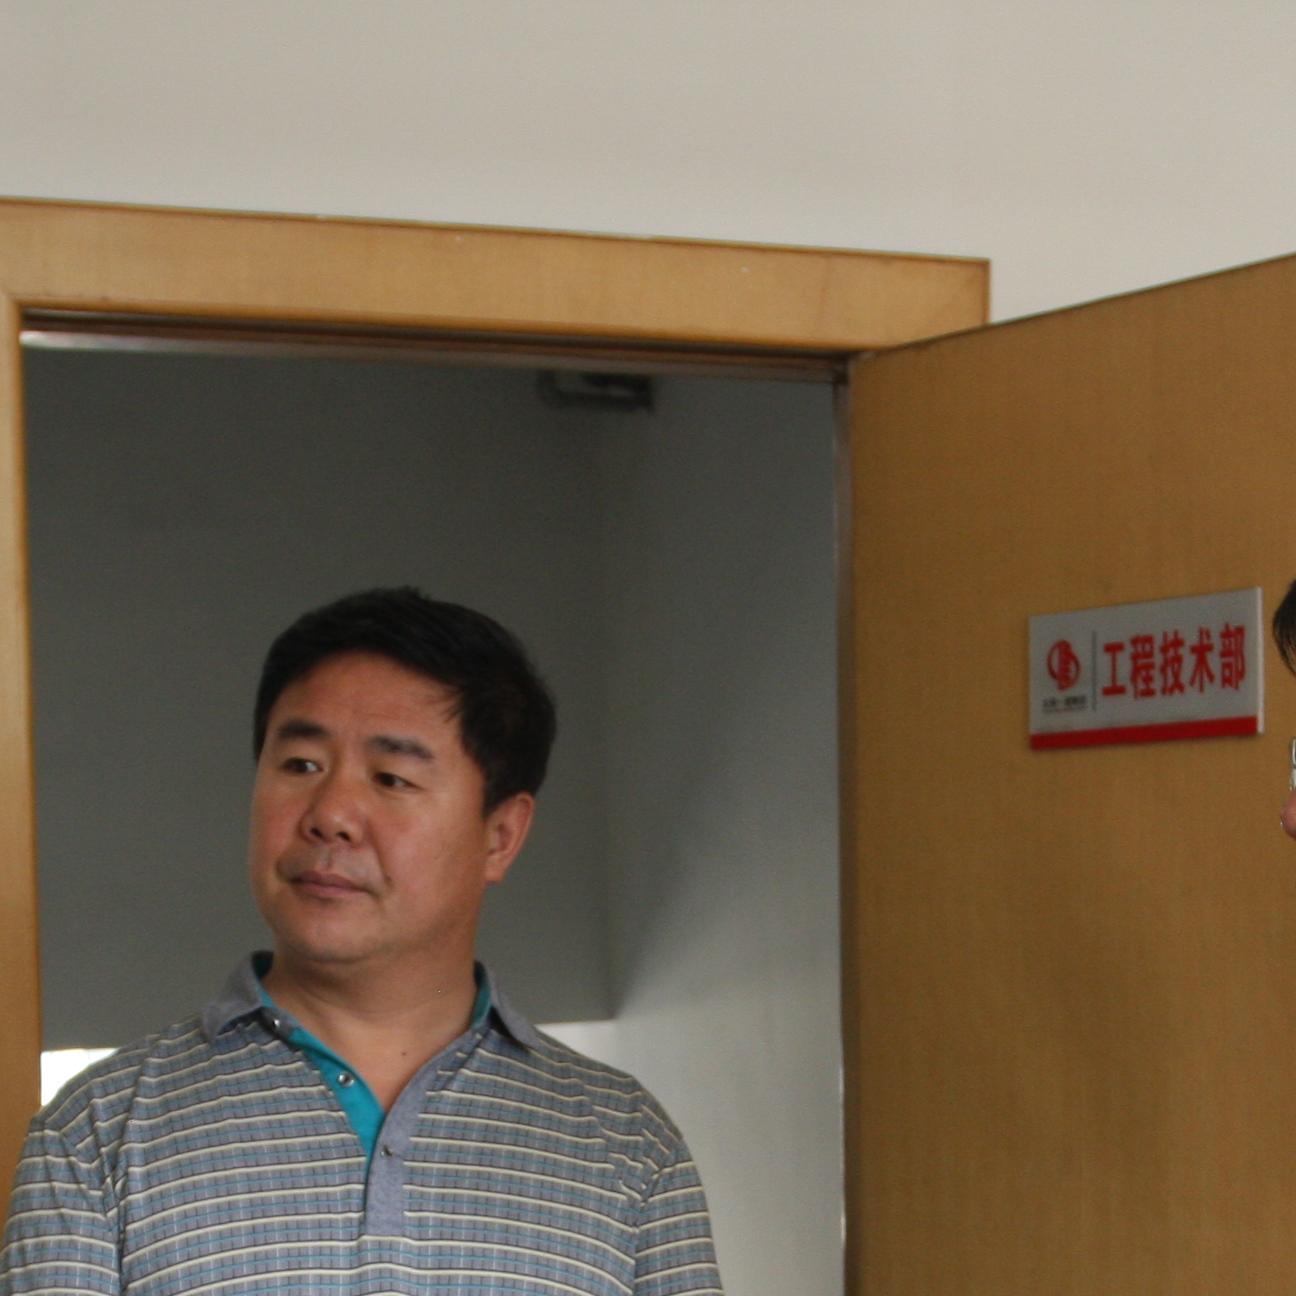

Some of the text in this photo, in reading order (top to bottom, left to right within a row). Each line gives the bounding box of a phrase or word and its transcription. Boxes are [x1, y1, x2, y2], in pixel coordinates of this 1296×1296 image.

[1102, 621, 1246, 699] 工程技术部
